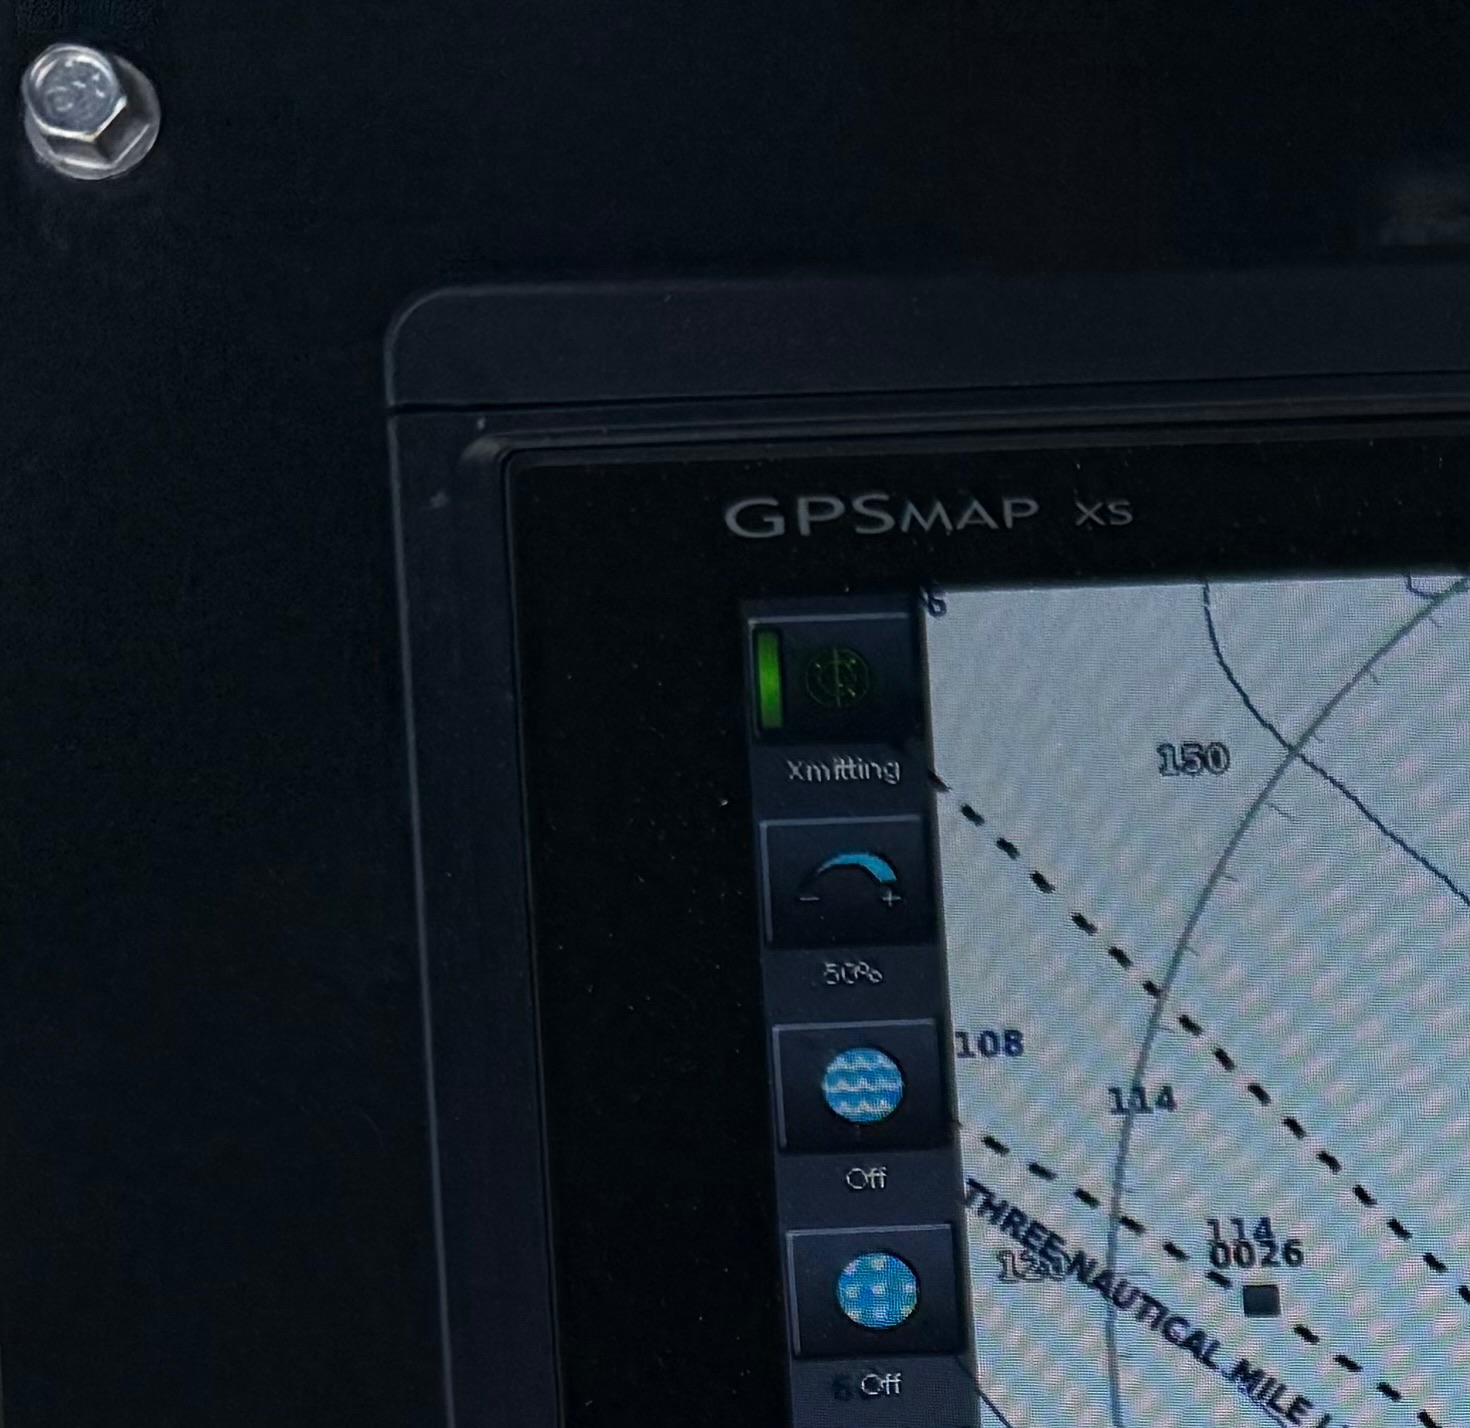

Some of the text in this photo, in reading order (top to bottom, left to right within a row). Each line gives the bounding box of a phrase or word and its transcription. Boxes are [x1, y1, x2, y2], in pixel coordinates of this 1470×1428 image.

[724, 492, 1039, 538] GPSMAP
[786, 756, 900, 786] Xmitting
[1157, 742, 1232, 778] 150
[822, 961, 883, 986] 50%
[955, 1029, 1024, 1058] 108
[1108, 1085, 1176, 1116] 114
[846, 1166, 888, 1192] Off
[1207, 1217, 1274, 1242] 114
[1209, 1239, 1304, 1269] 0026
[966, 1178, 1068, 1258] THREE
[1067, 1250, 1221, 1369] NAUTICAL
[1228, 1359, 1313, 1425] MILE
[861, 1373, 902, 1395] Off
